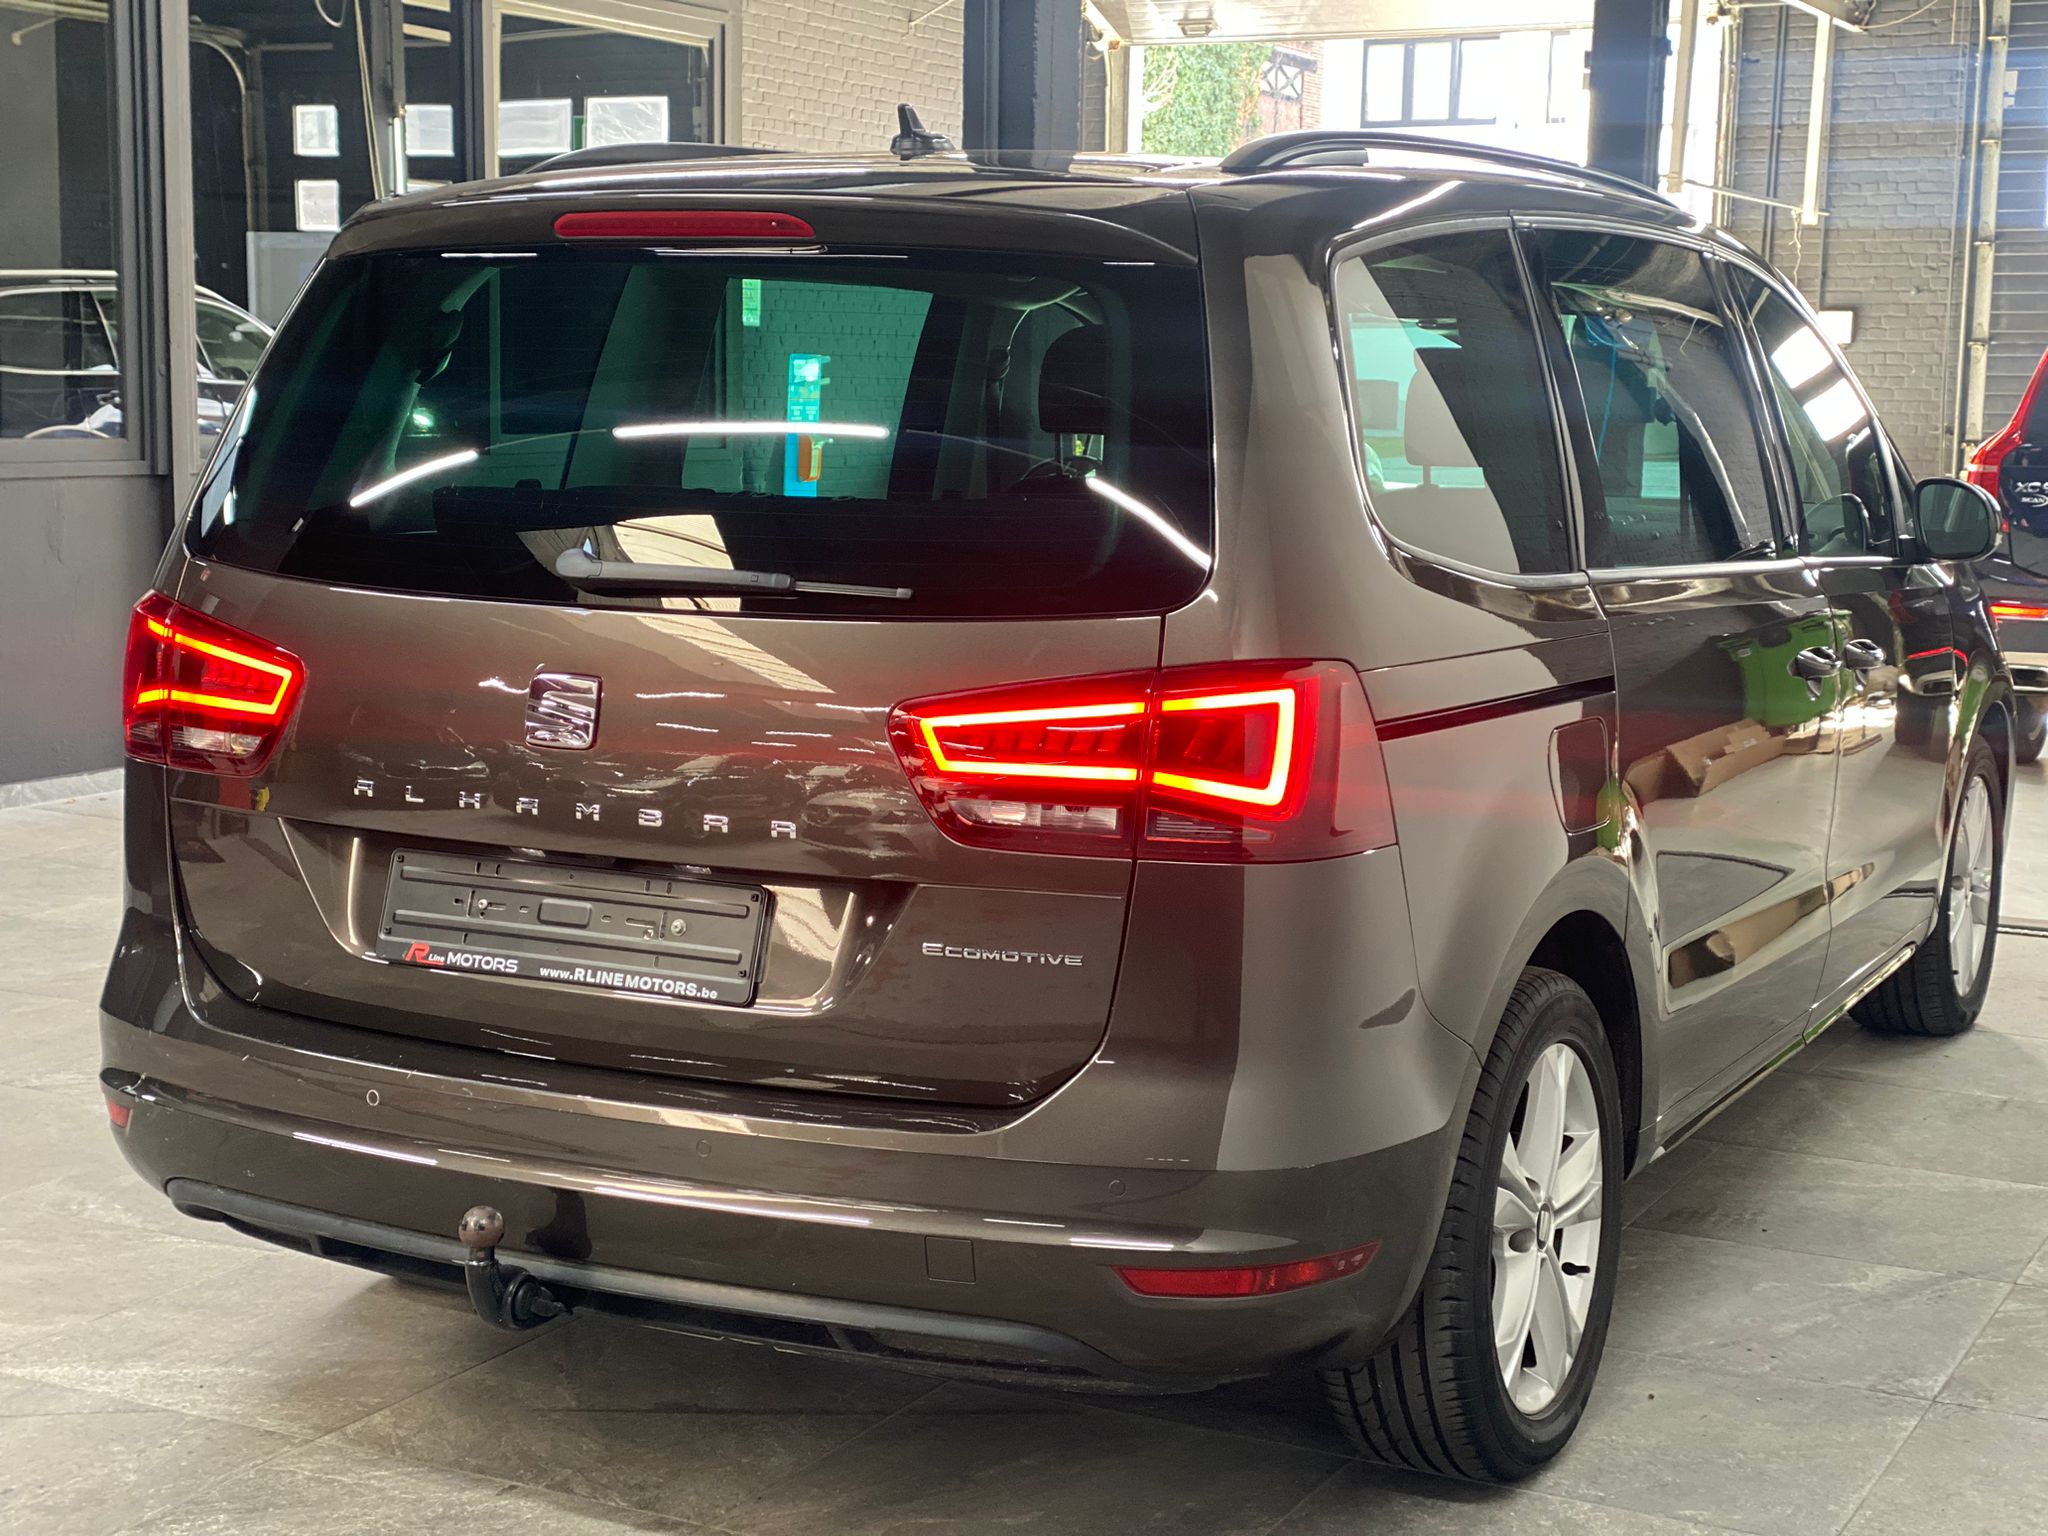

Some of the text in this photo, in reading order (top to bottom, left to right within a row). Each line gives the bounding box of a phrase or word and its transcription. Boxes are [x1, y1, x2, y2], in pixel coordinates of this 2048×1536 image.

[353, 779, 797, 839] ALHAMBRA
[446, 951, 519, 973] MOTORS
[921, 942, 1084, 966] ECOMOTIVE
[539, 967, 719, 1000] www.RLINEMOTORS.be
